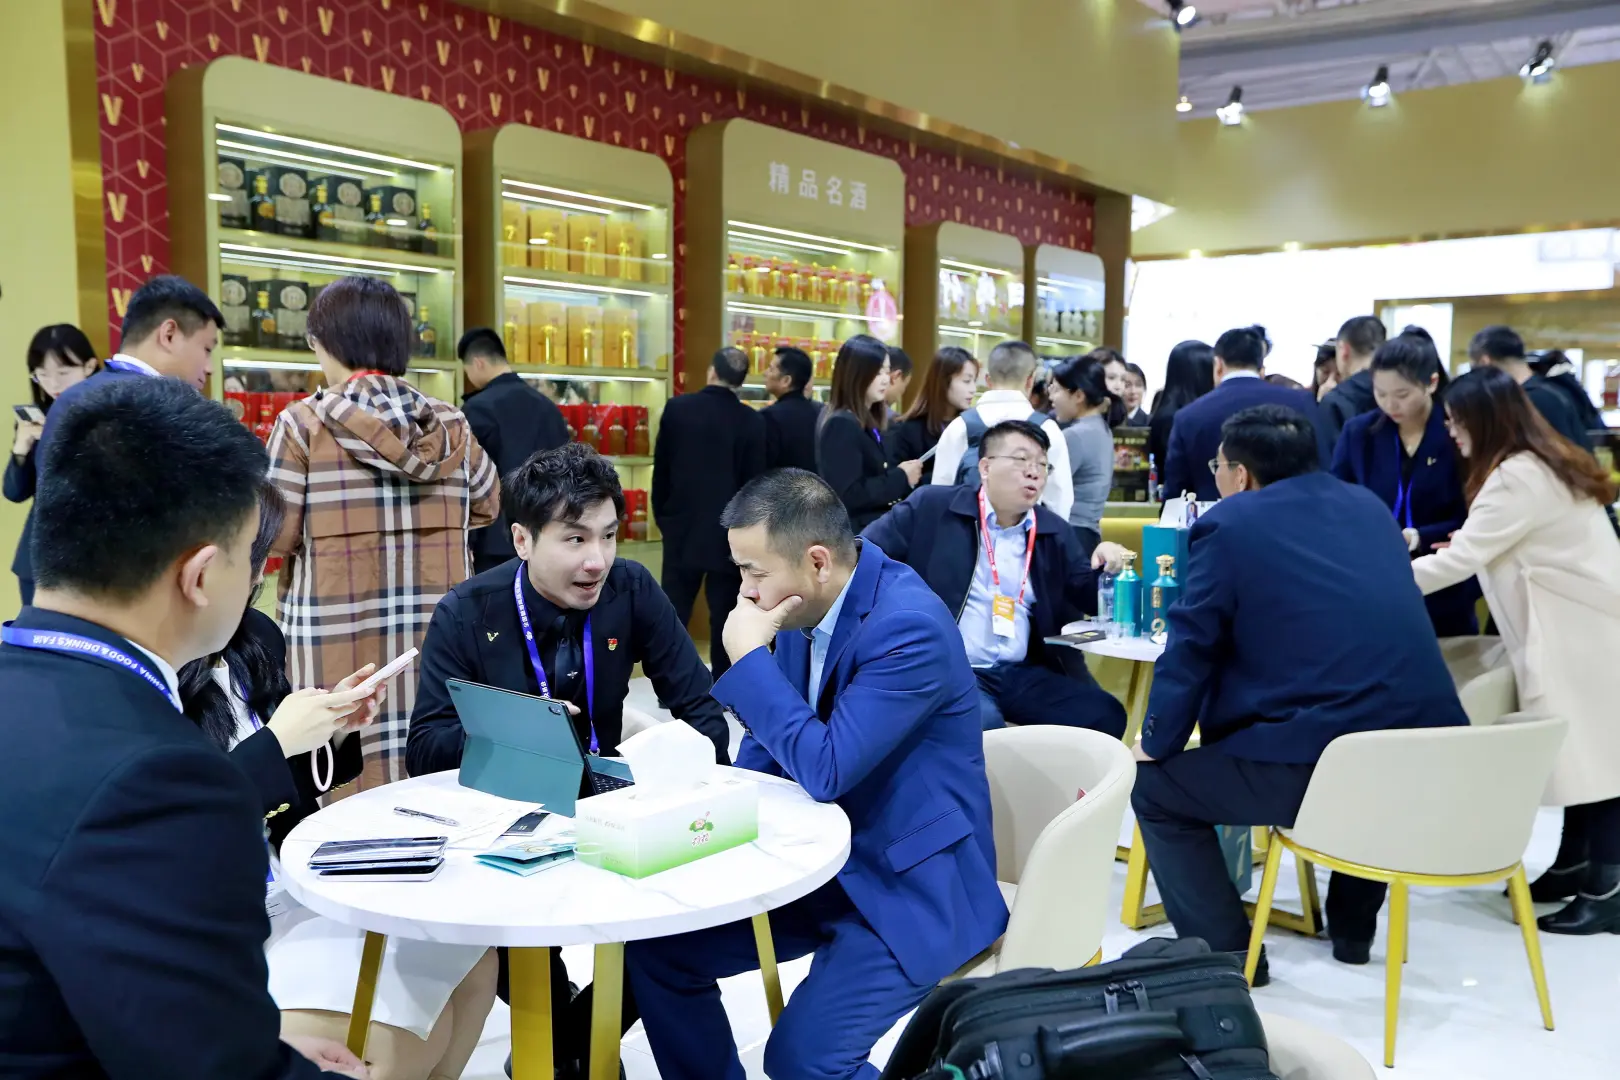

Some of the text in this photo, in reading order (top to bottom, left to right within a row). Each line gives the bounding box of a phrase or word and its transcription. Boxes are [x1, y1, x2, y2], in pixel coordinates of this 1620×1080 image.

[769, 161, 867, 211] 精品名酒
[33, 635, 56, 645] FAIR
[57, 637, 101, 653] DRINKS
[108, 651, 138, 669] FOOD
